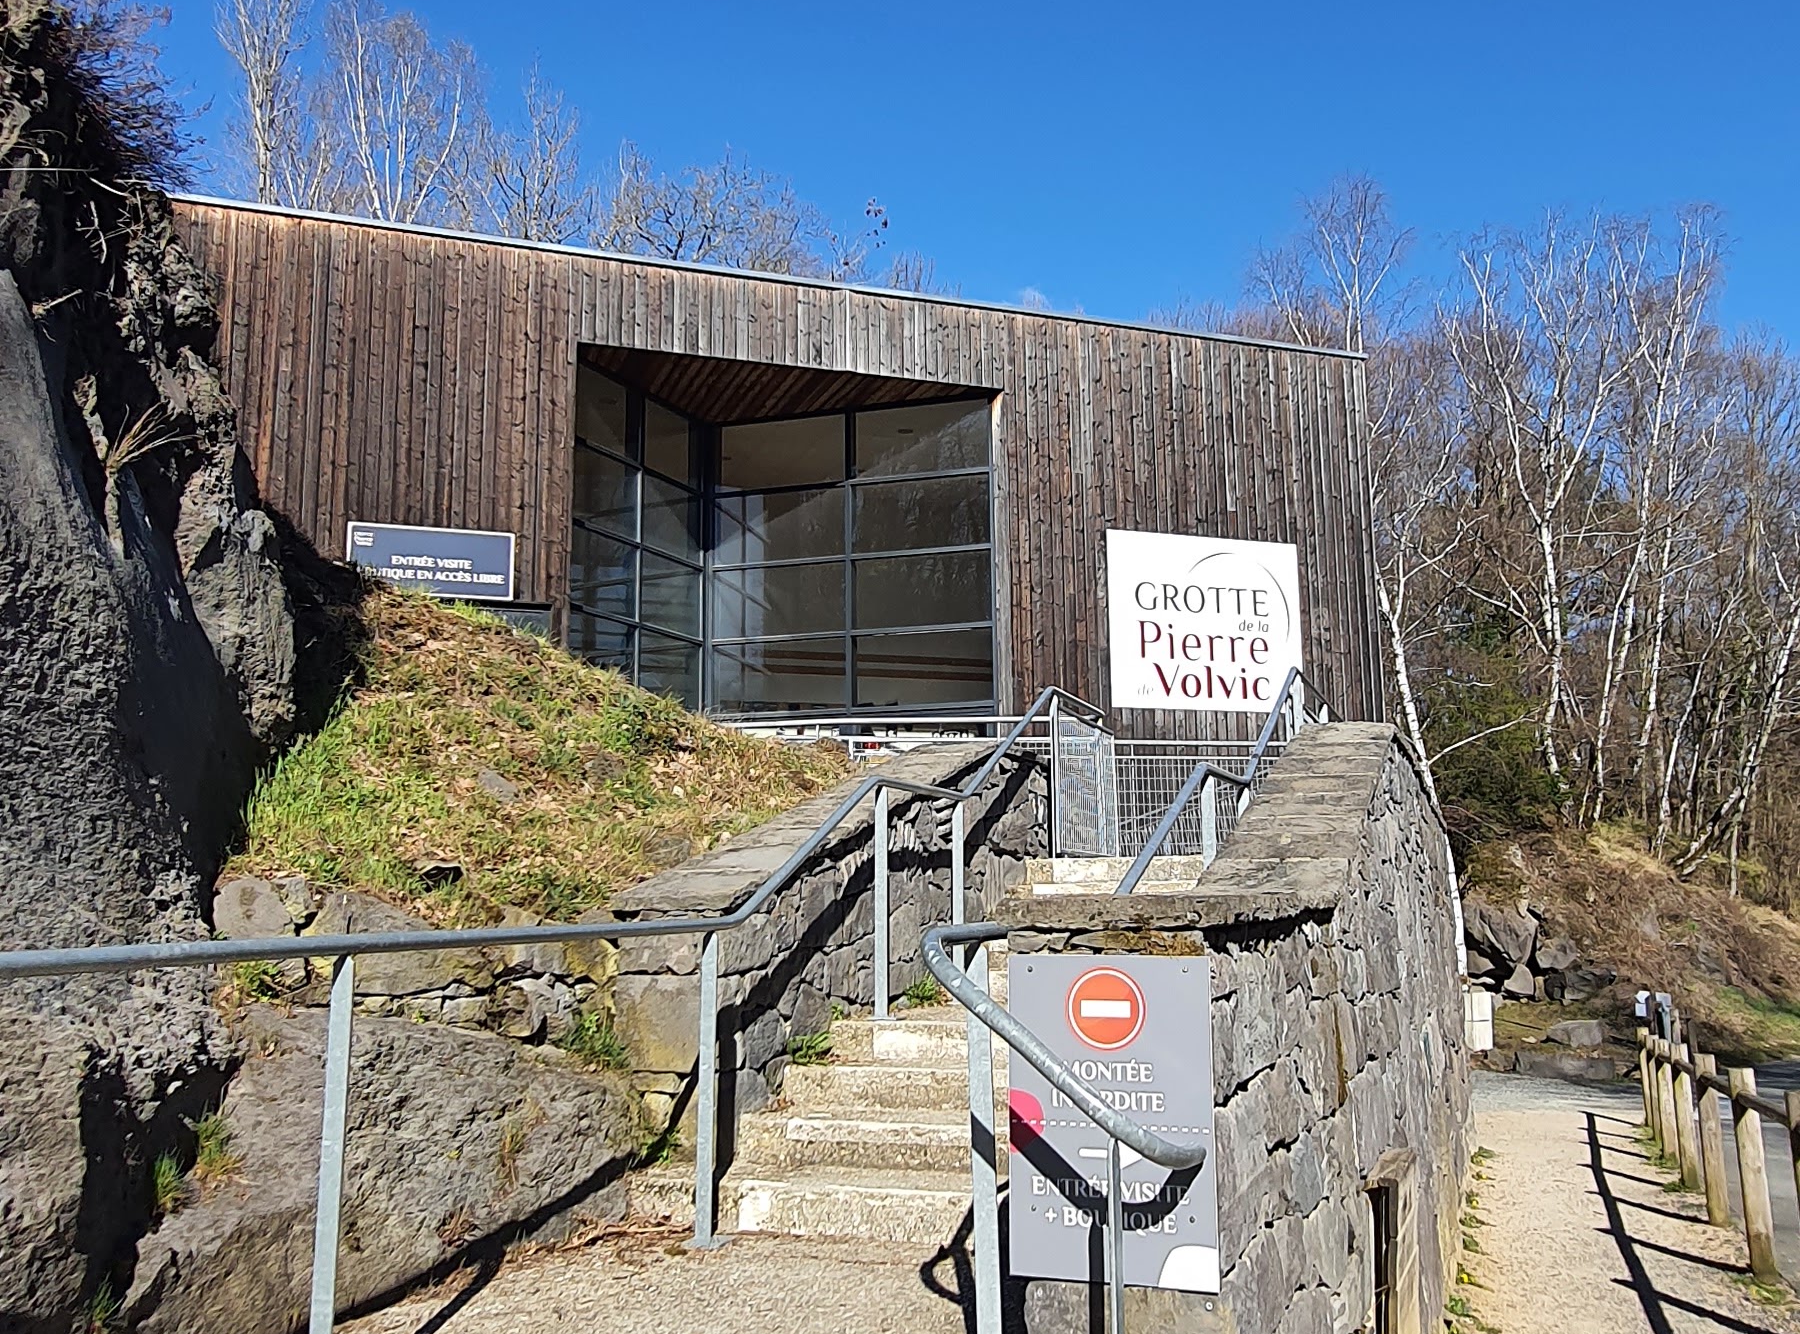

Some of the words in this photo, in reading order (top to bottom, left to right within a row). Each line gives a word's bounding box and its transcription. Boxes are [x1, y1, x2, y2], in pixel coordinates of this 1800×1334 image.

[391, 555, 435, 567] ENTRÉE
[436, 558, 472, 570] VISITE
[416, 569, 433, 581] EN
[434, 570, 472, 583] ACCÈS
[473, 573, 505, 585] LIBRE
[1135, 581, 1269, 617] GROTTE
[1238, 619, 1254, 632] de
[1257, 620, 1269, 633] la
[1137, 620, 1269, 665] Pierre
[1152, 662, 1271, 701] Volvic
[1051, 1087, 1165, 1112] INRDITE
[1120, 1181, 1191, 1205] VISITE
[1062, 1206, 1177, 1237] BOUIQUE
